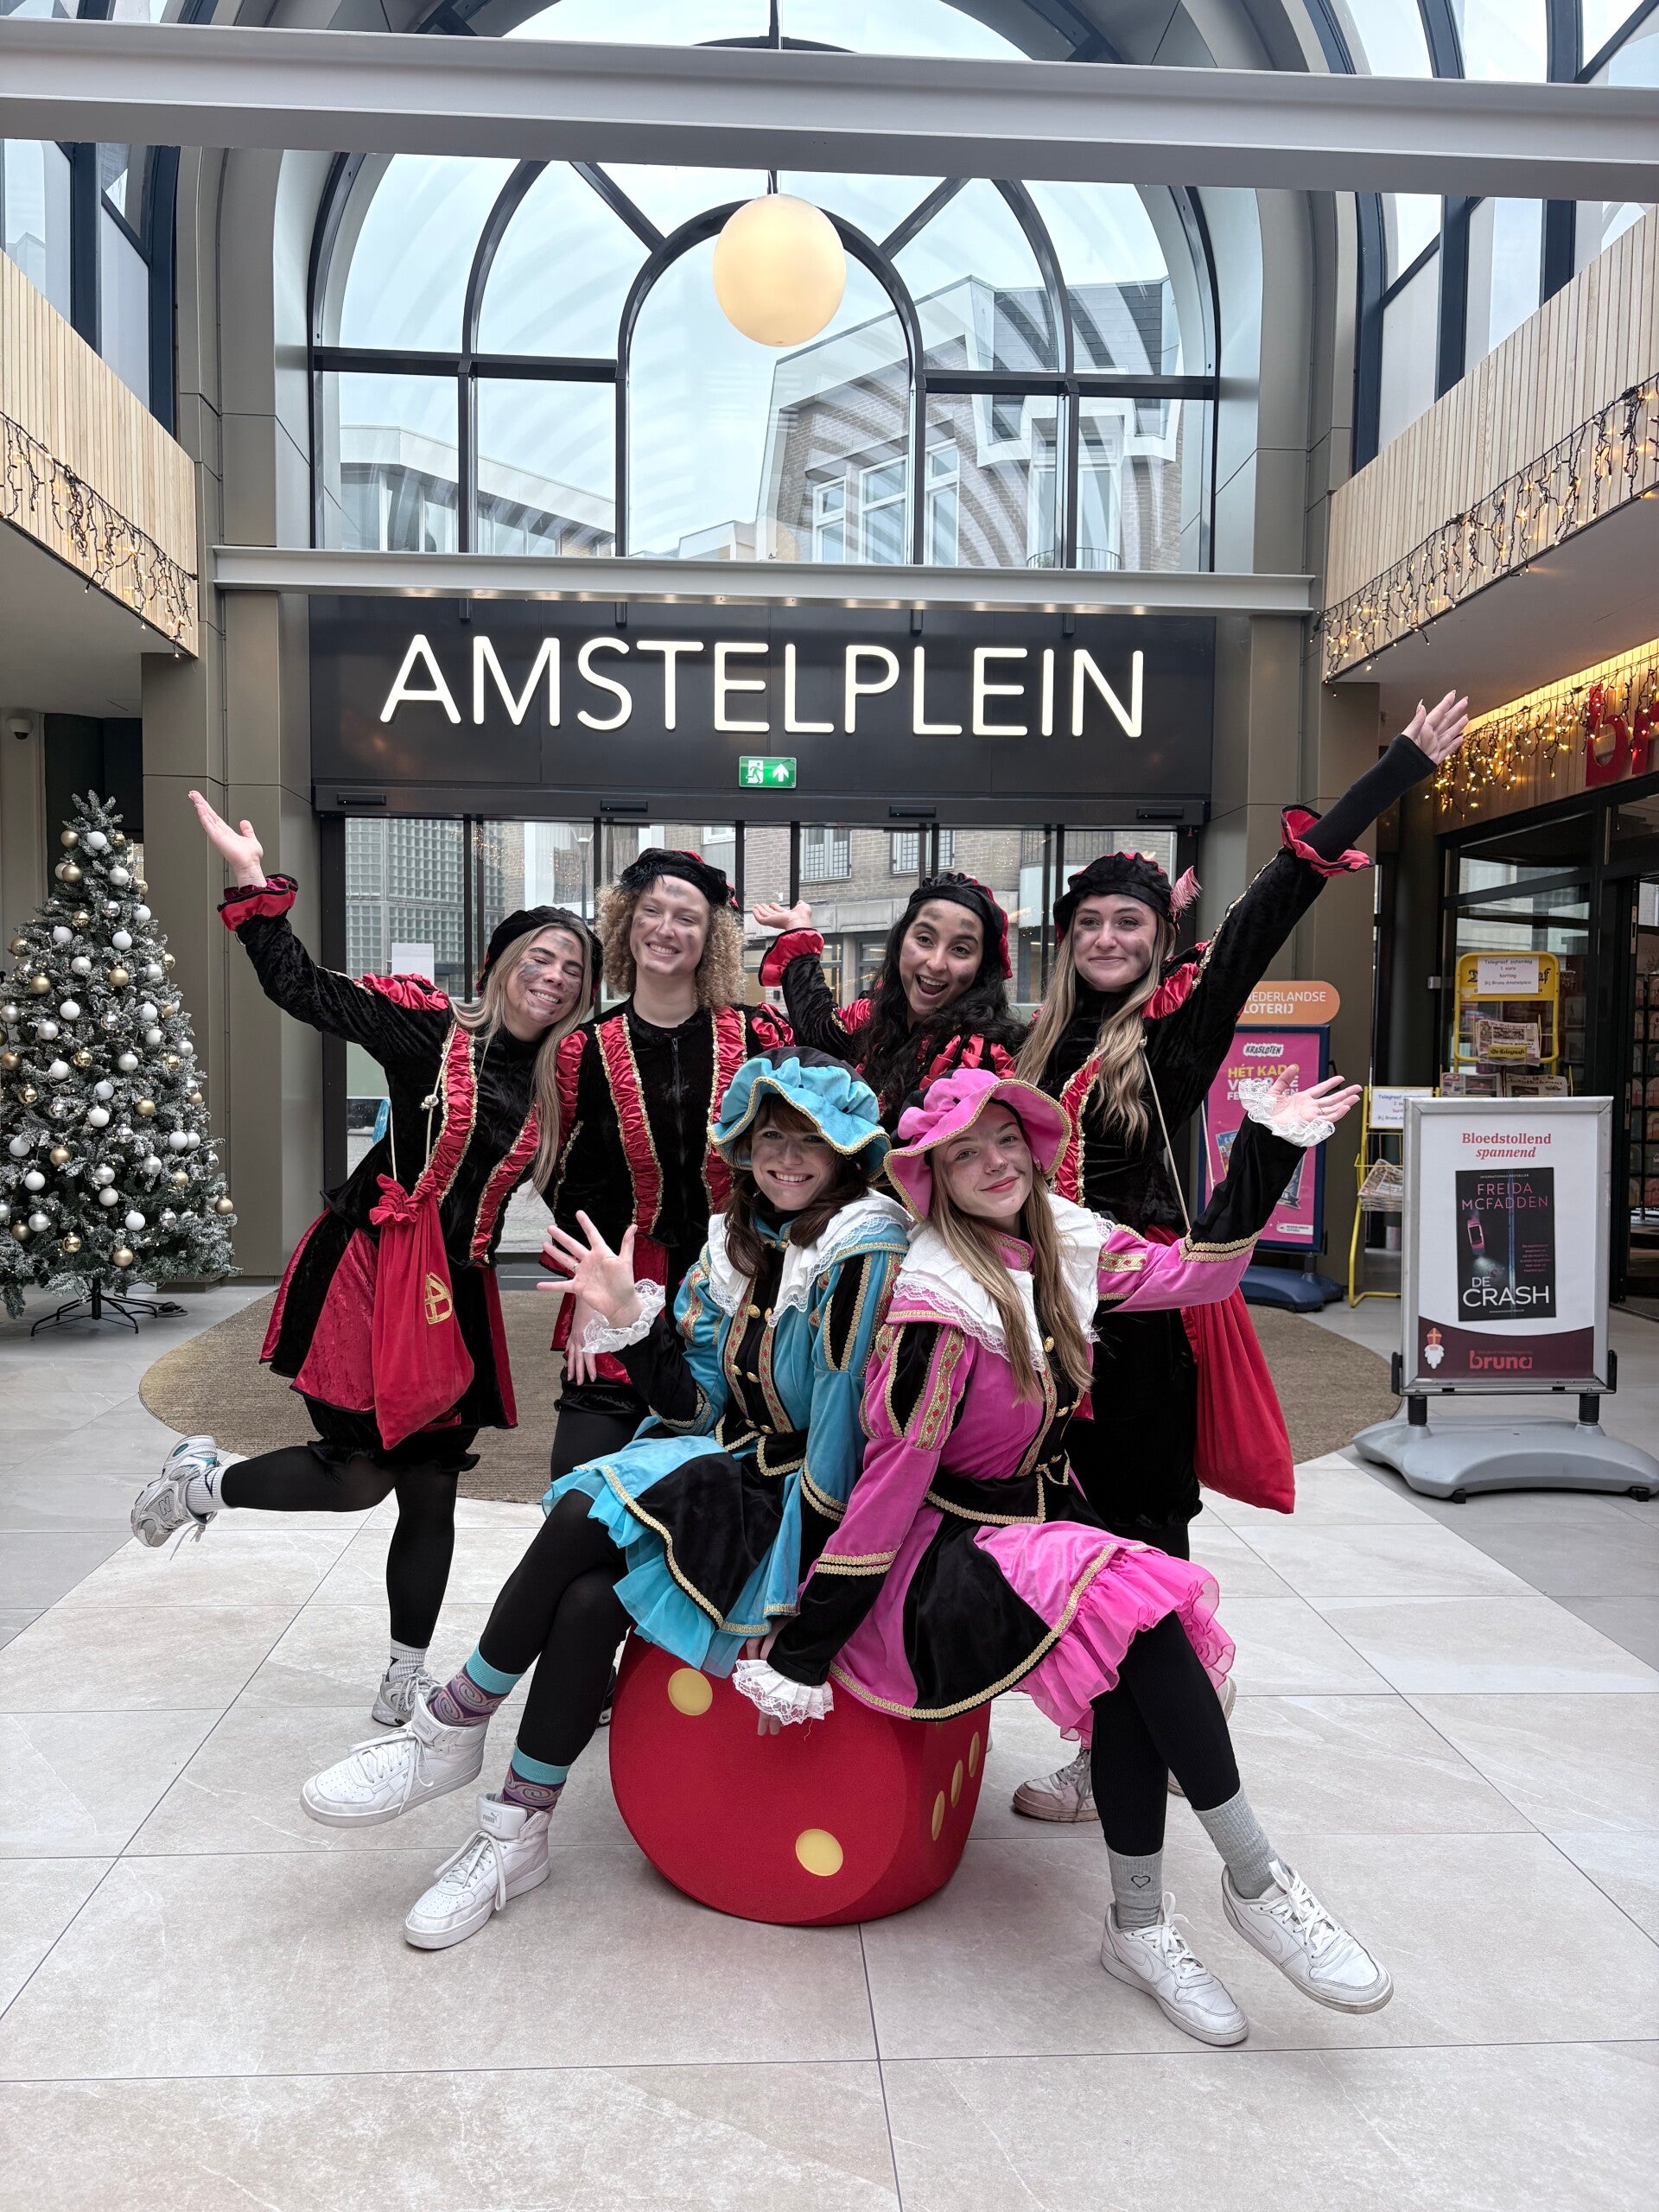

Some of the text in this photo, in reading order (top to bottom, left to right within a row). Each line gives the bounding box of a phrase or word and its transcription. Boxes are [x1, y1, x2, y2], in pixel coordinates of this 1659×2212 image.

[379, 633, 1144, 739] AMSTELPLEIN
[1243, 1003, 1294, 1014] LOTERIJ
[1245, 1045, 1281, 1055] KRASLOTEN
[1228, 1064, 1255, 1078] HÉT
[1462, 1133, 1552, 1144] Bloedstollend
[1476, 1147, 1536, 1160] spannend
[1478, 1182, 1533, 1195] FREIDA
[1461, 1196, 1548, 1211] MCFADDEN
[1471, 1276, 1491, 1287] DE
[1462, 1285, 1549, 1307] CRASH
[1469, 1350, 1533, 1370] bruna
